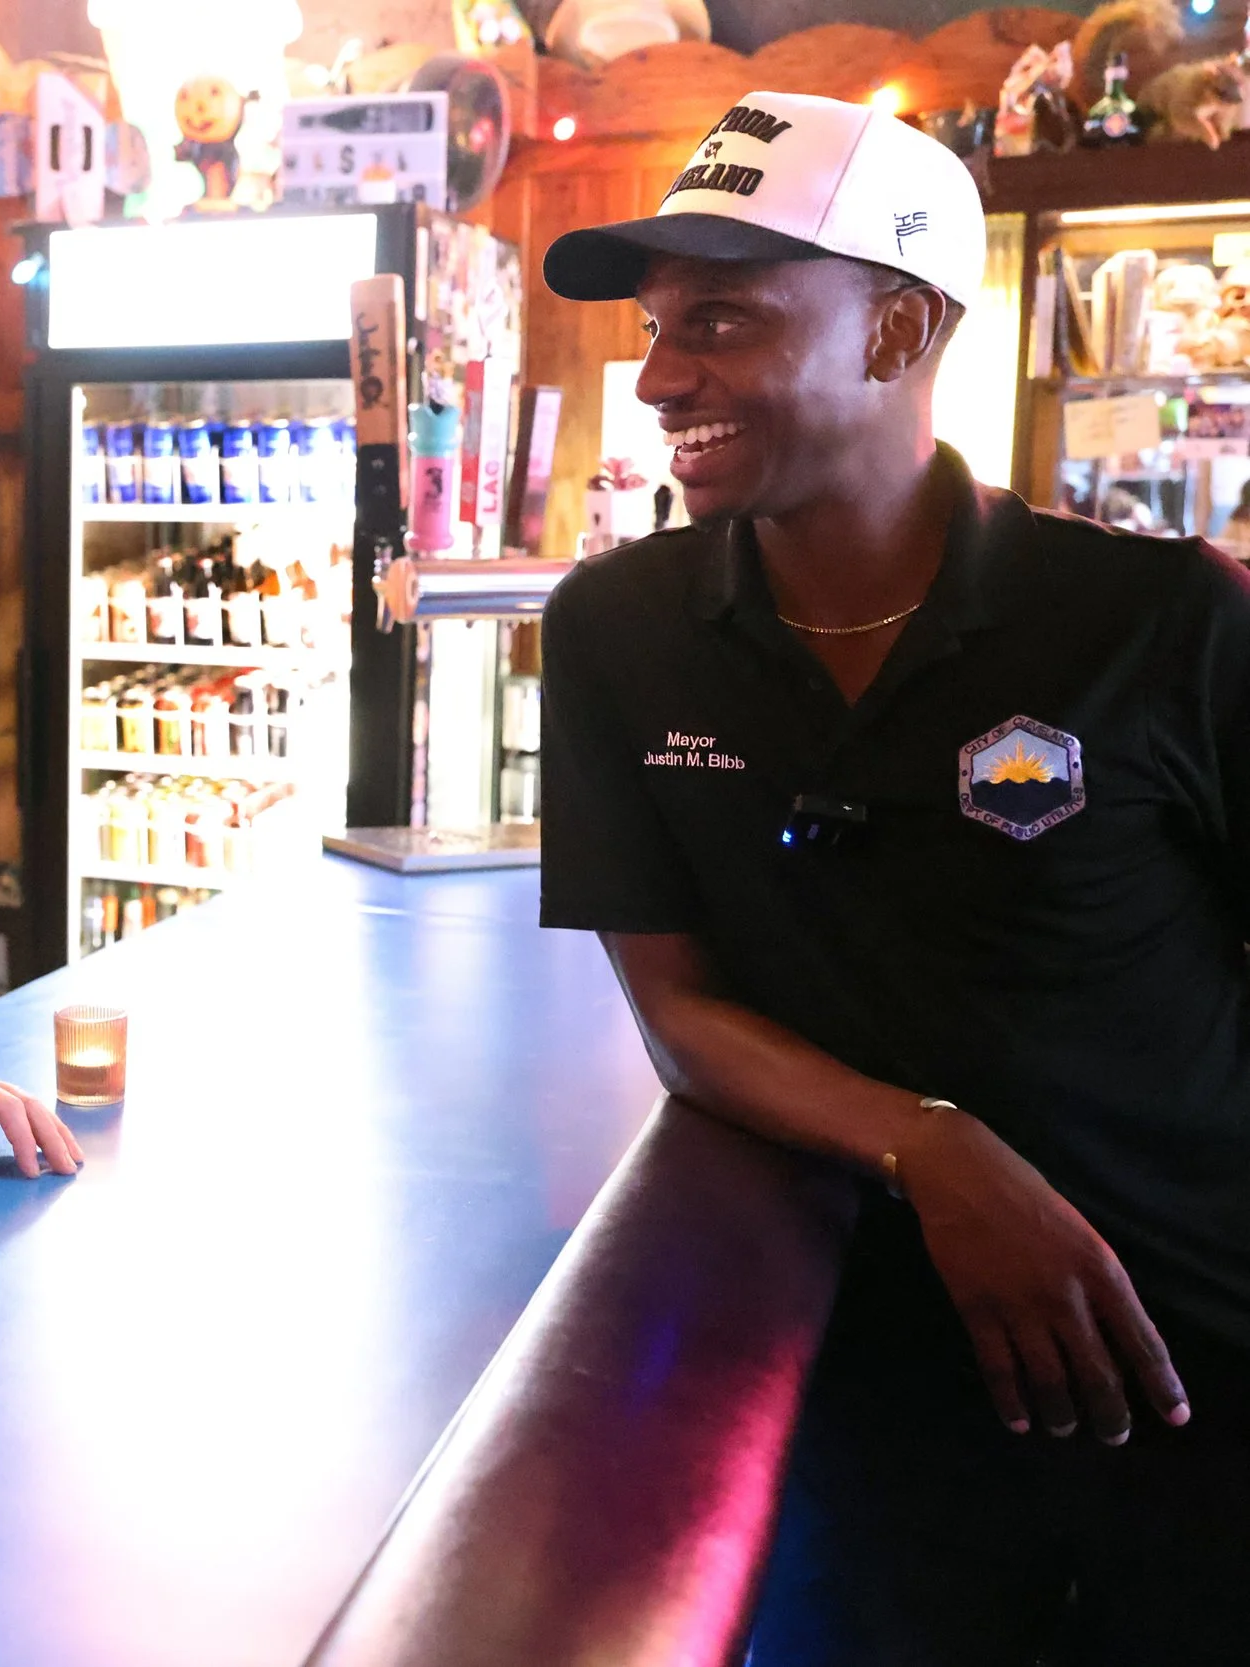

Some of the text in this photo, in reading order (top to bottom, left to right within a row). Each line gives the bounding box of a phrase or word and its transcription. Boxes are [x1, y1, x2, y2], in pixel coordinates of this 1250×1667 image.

[667, 731, 717, 750] Mayor
[964, 734, 989, 755] CITY
[644, 751, 746, 770] Justin M. Bibb
[983, 813, 1002, 825] OF
